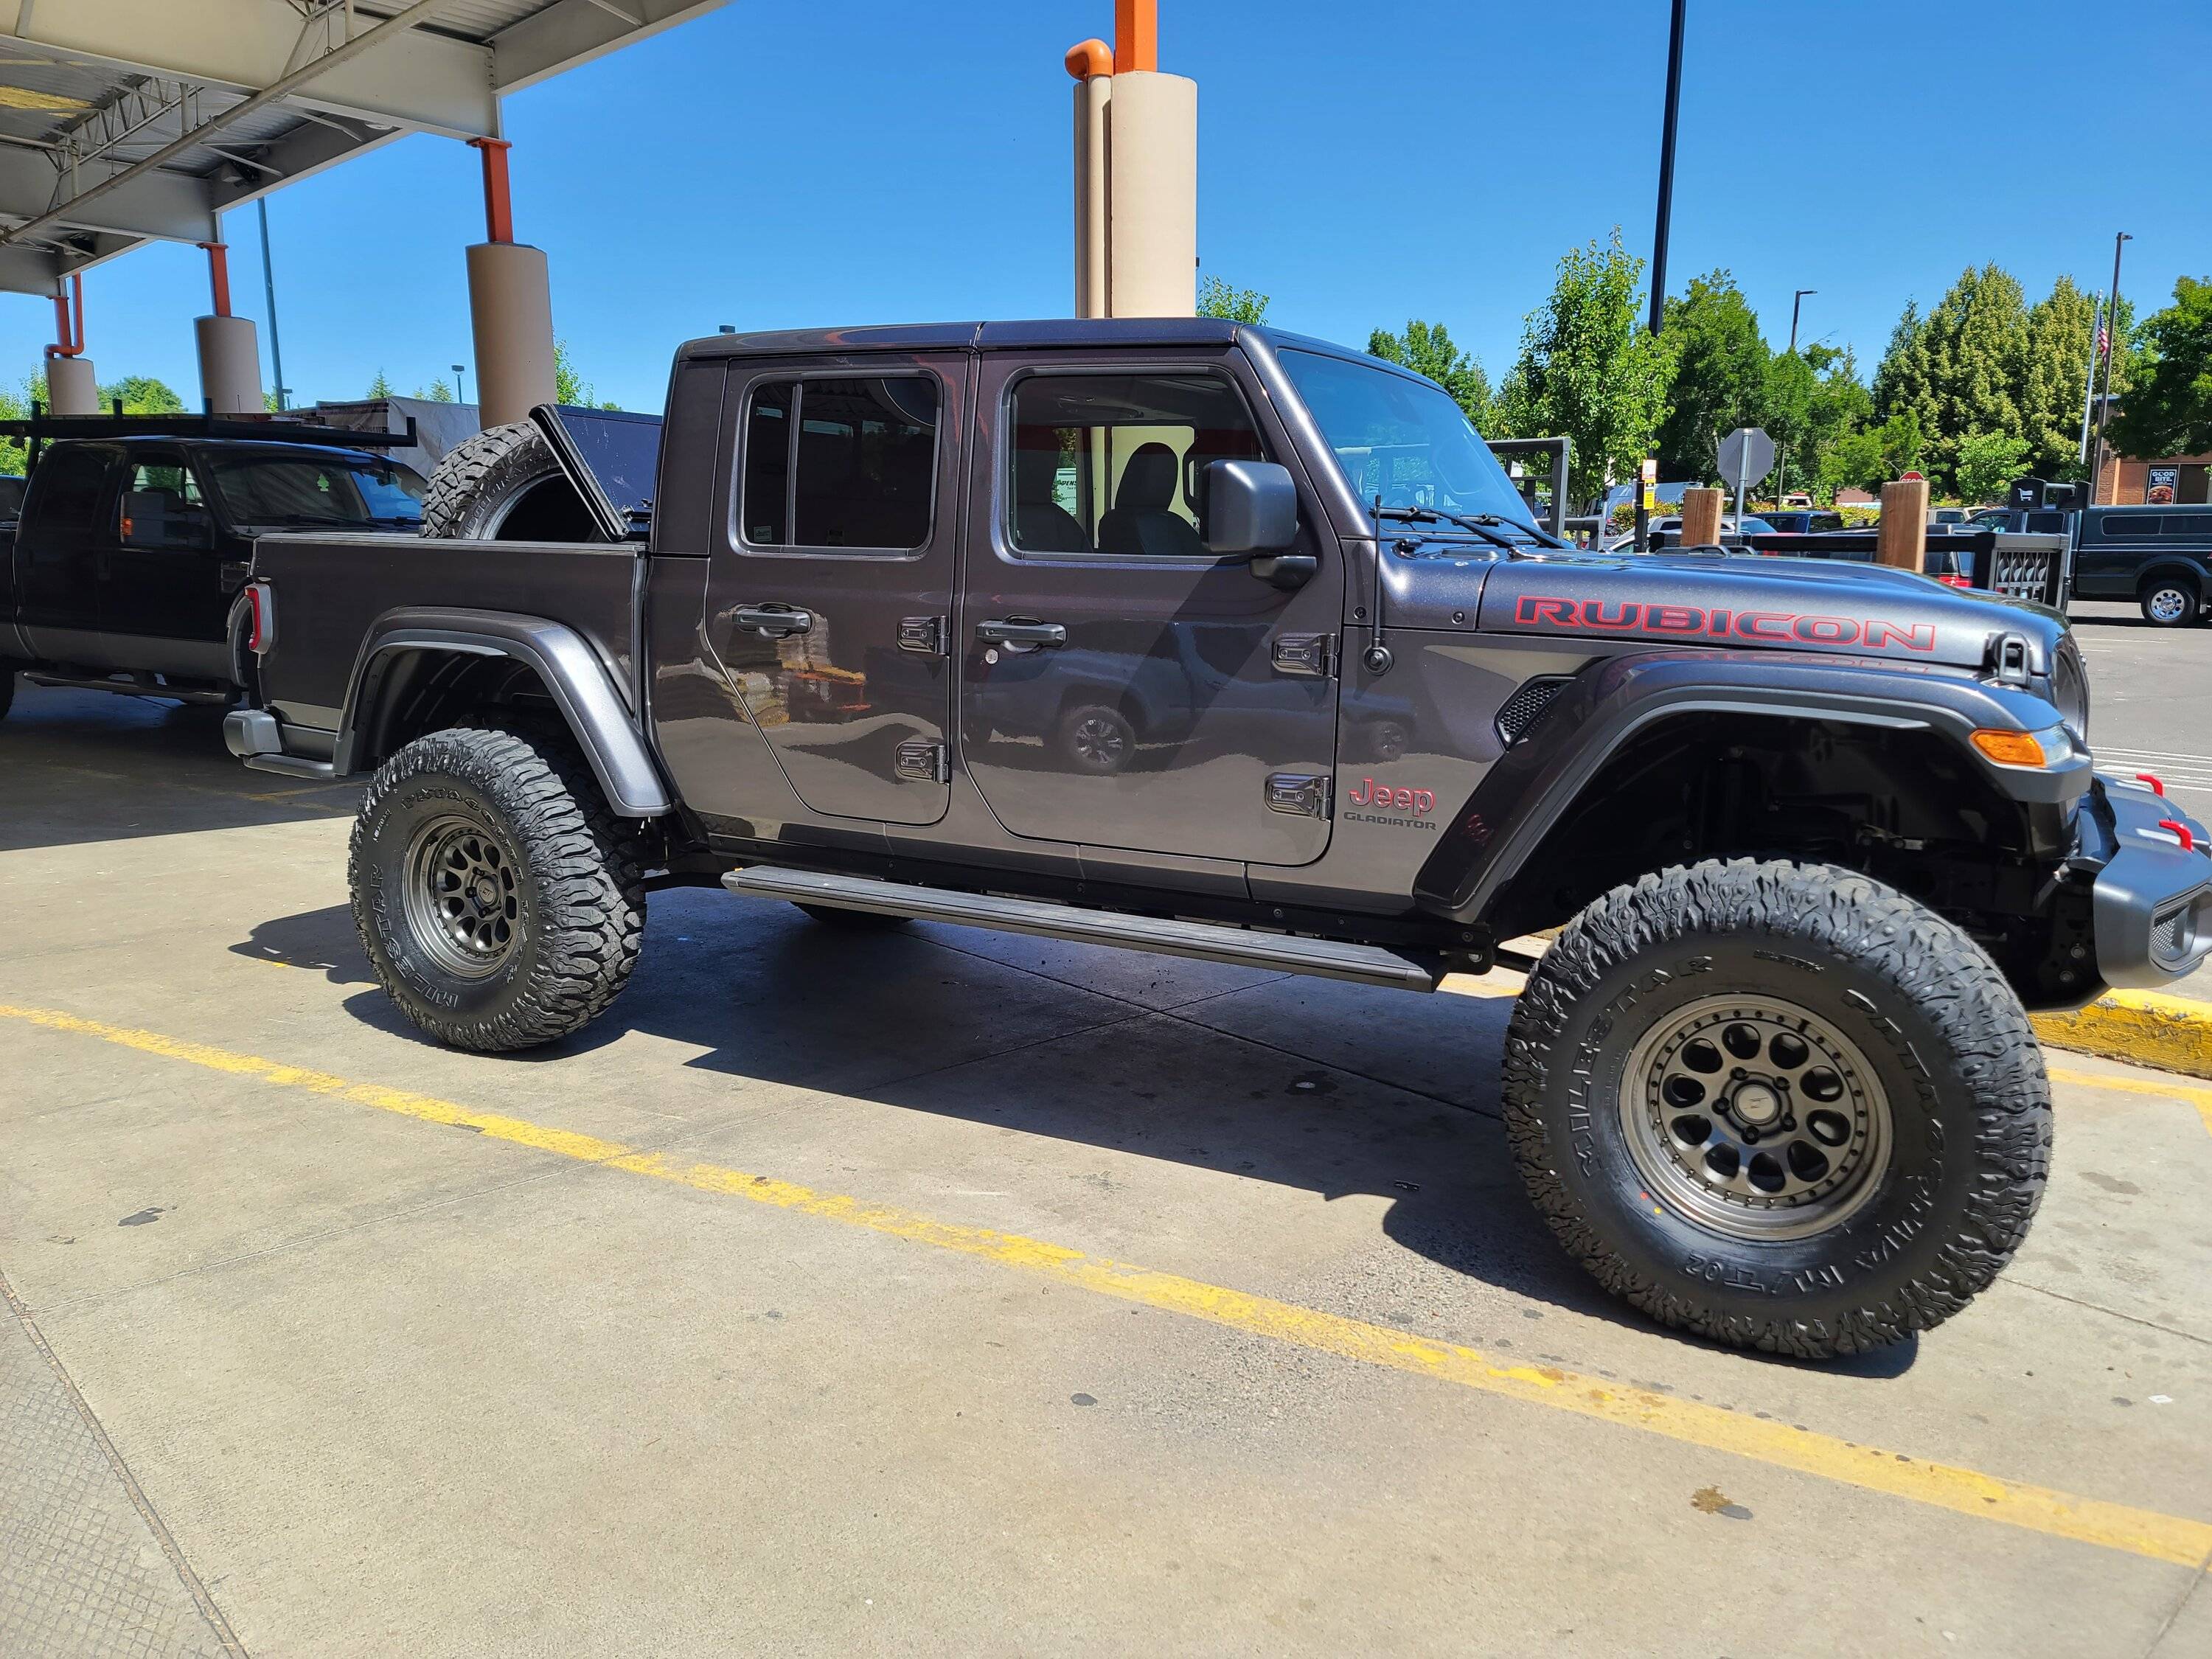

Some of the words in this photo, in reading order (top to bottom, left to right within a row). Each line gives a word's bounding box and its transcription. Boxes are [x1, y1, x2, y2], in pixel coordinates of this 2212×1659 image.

[1514, 596, 1936, 652] RUBICON
[1343, 811, 1437, 830] GLADIATOR
[1349, 778, 1436, 817] Jeep
[370, 863, 459, 1008] MILESTAR
[1568, 956, 1714, 1179] MILESTAR
